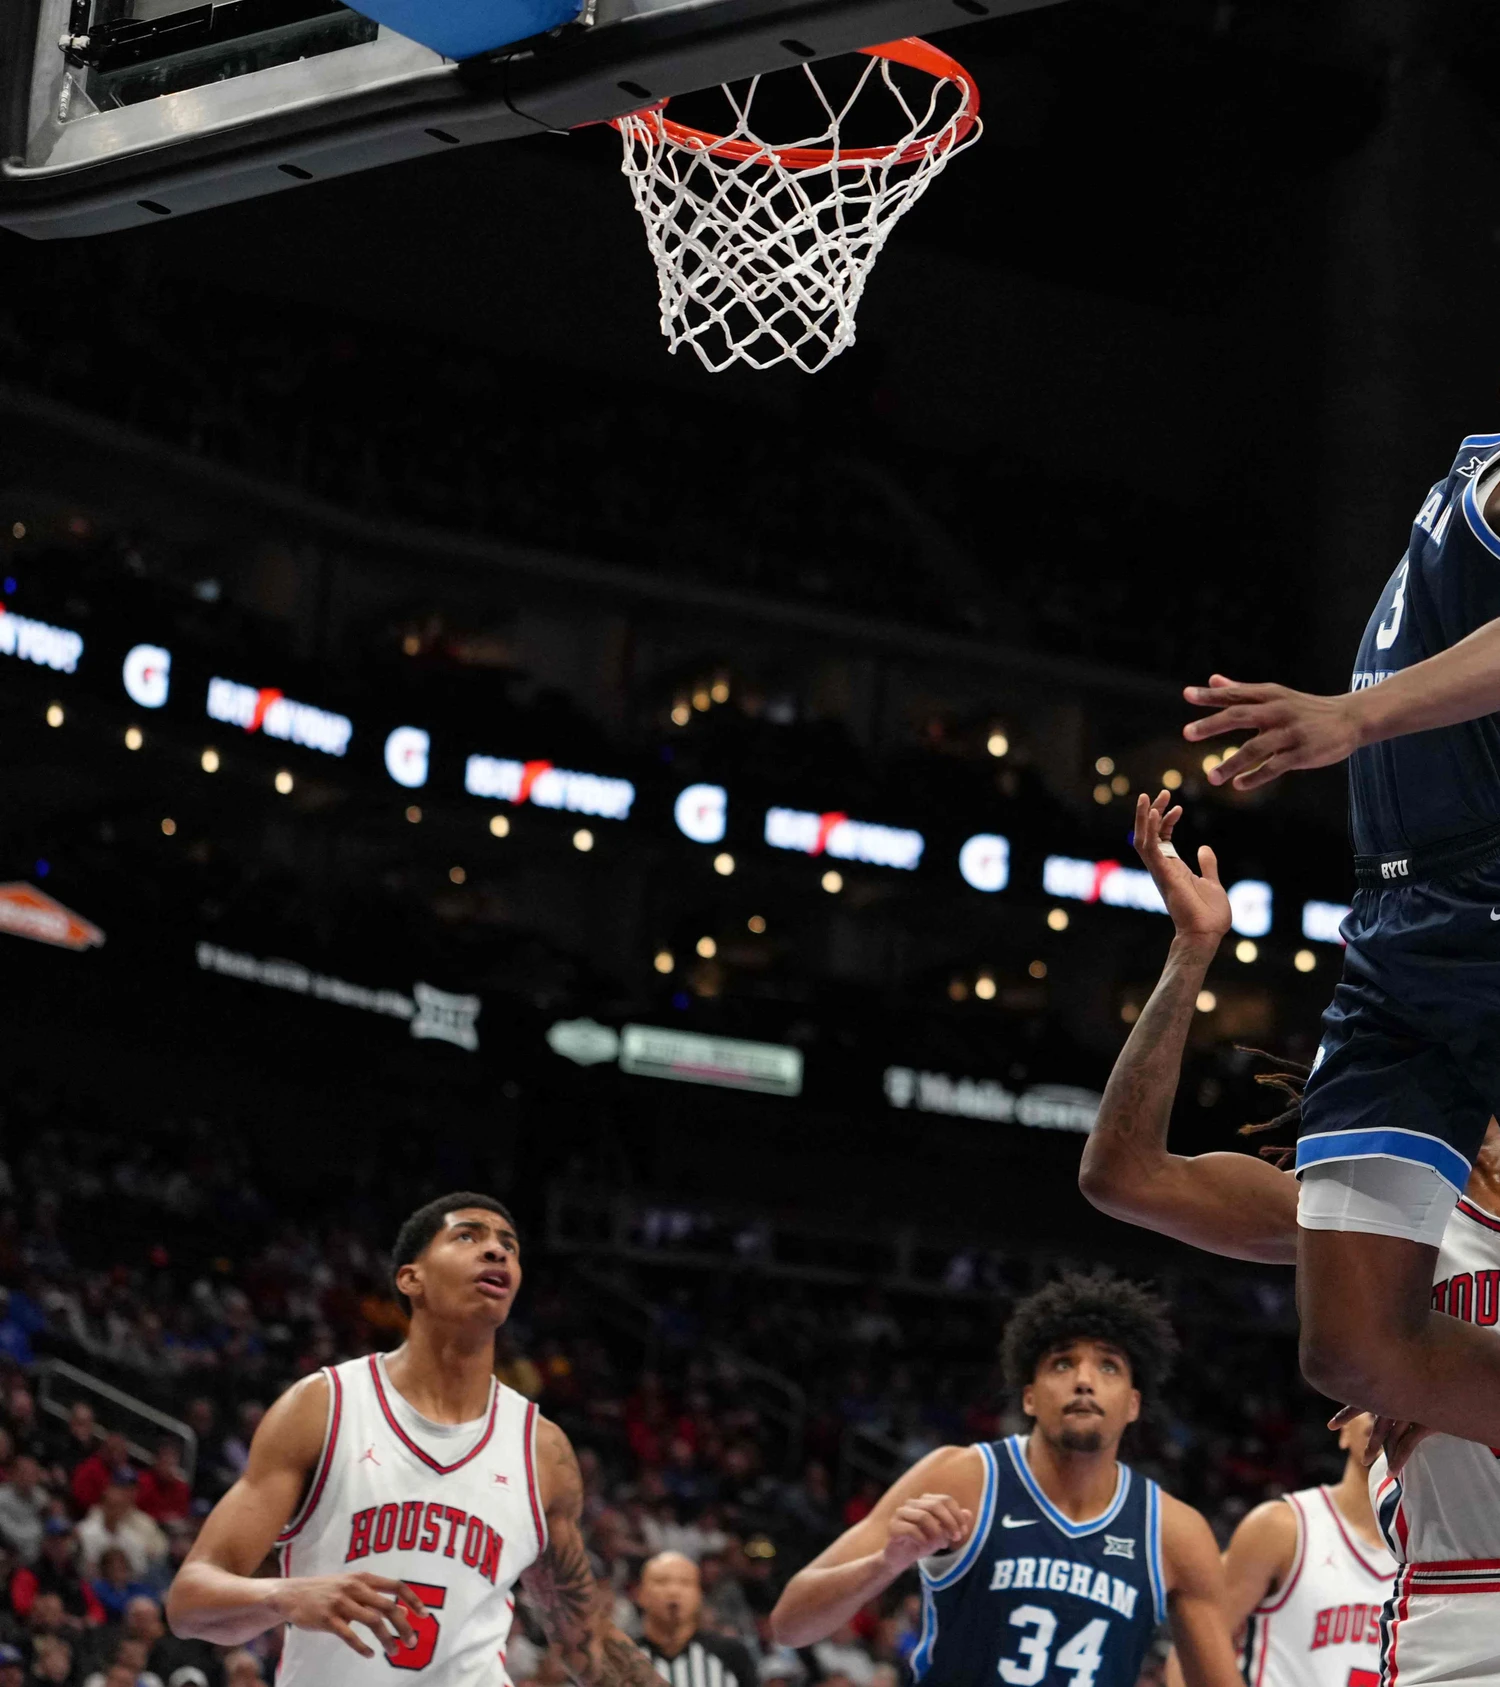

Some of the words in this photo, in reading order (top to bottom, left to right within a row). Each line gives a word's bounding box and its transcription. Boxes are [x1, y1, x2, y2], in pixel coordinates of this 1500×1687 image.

[1376, 560, 1410, 650] 3
[1381, 859, 1409, 879] BYU
[345, 1501, 504, 1585] HOUSTON
[384, 1580, 447, 1671] 5
[989, 1557, 1138, 1619] BRIGHAM
[1309, 1603, 1381, 1652] HOUS
[998, 1604, 1110, 1687] 34
